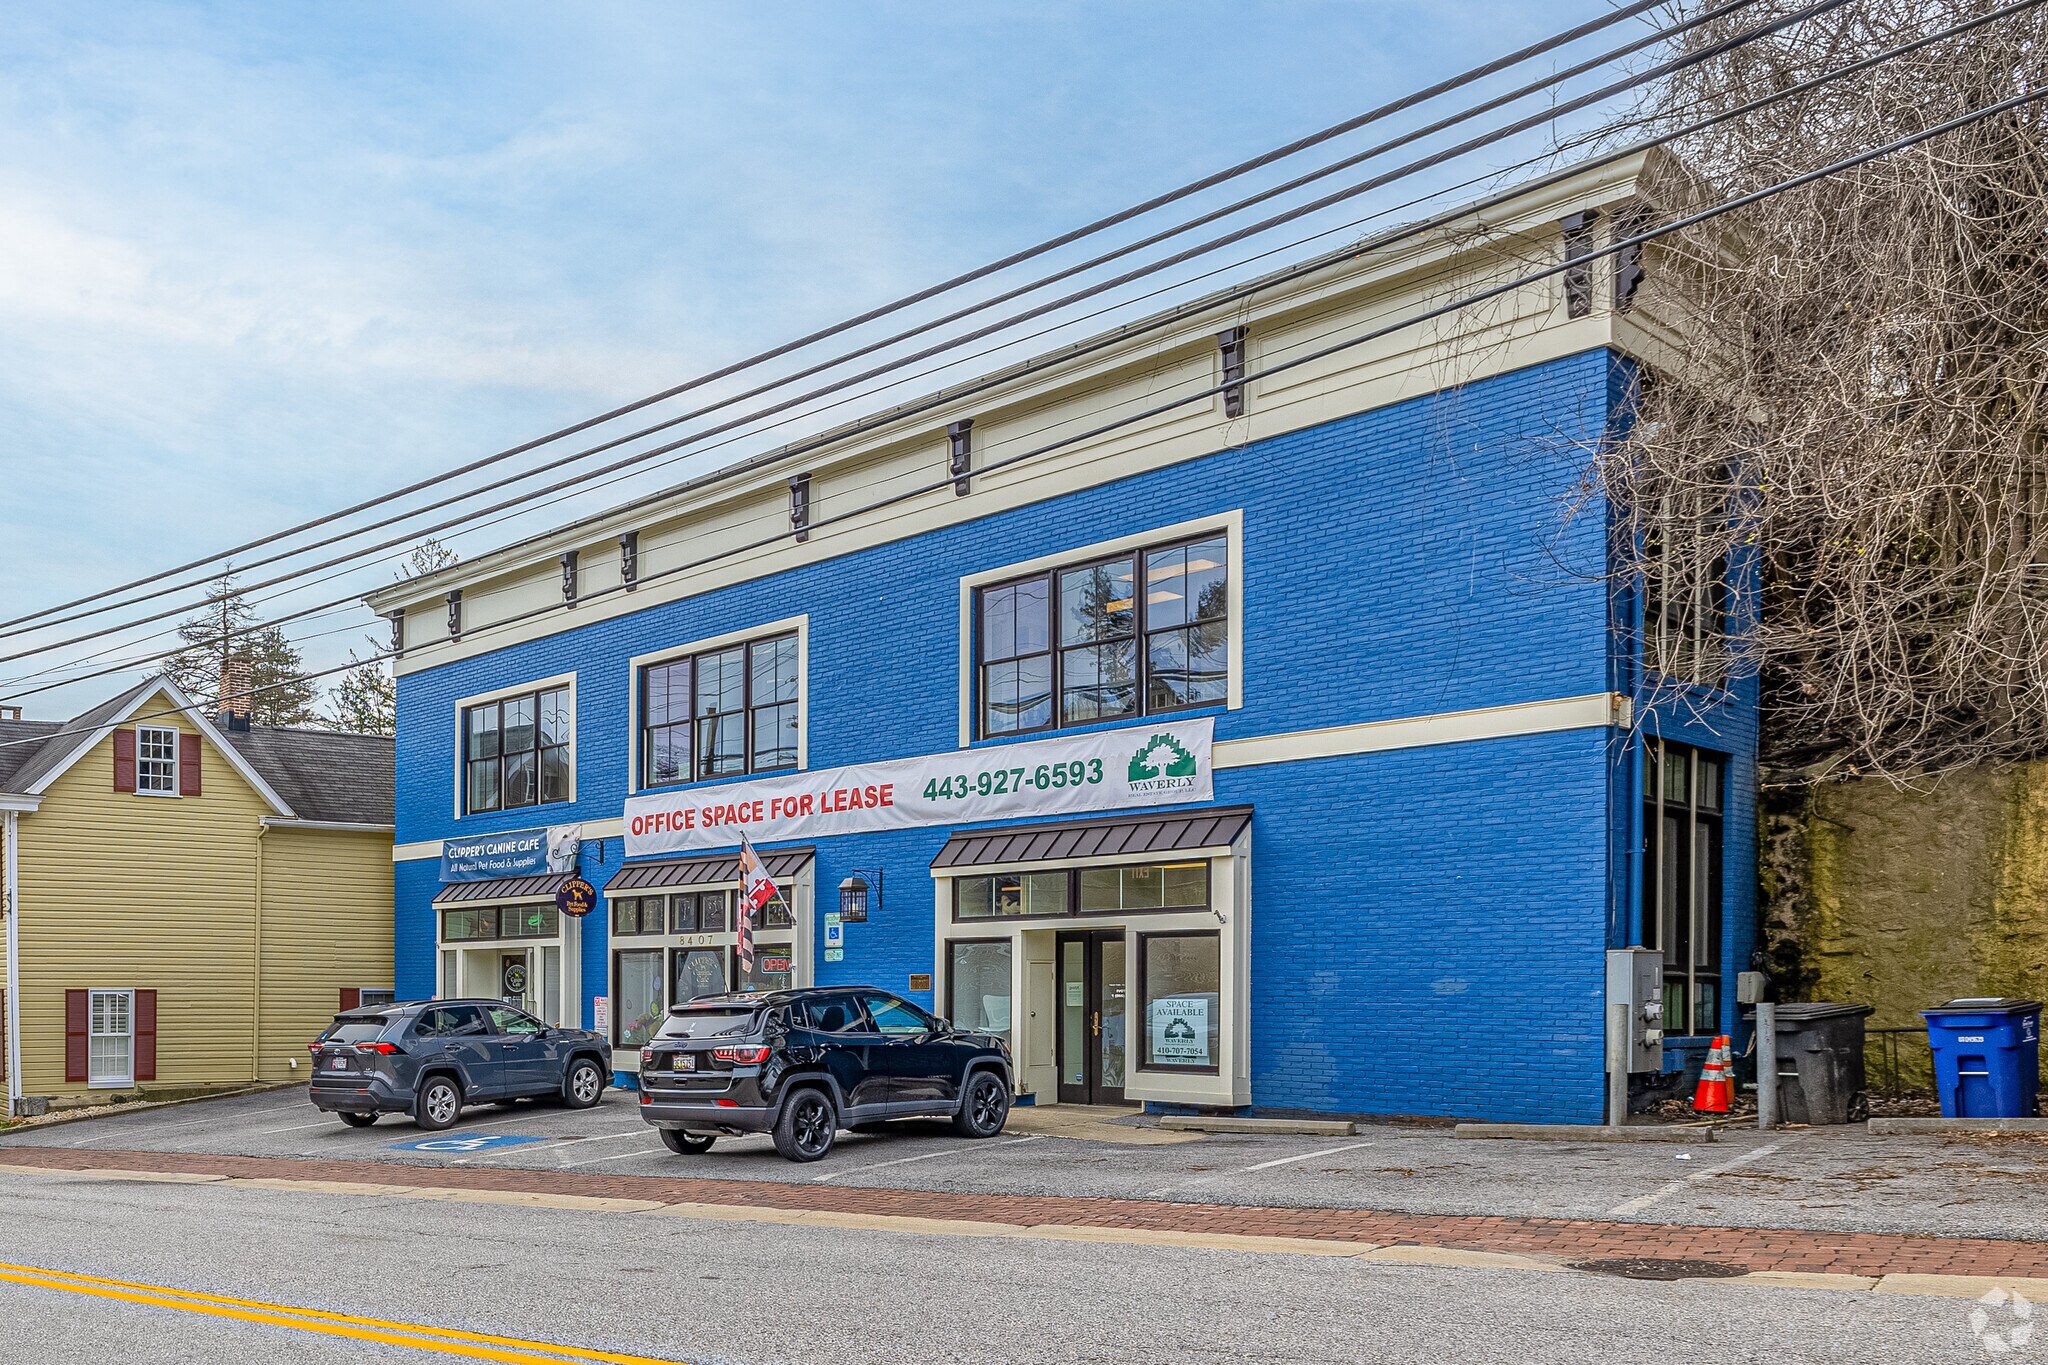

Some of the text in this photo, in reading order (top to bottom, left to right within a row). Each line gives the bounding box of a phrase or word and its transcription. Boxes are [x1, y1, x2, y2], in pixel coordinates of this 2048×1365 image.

[923, 758, 1104, 801] 443-927-6593
[1129, 777, 1196, 792] WAVERLY
[631, 784, 894, 836] OFFICE SPACE FOR LEASE
[448, 838, 540, 859] CLIPPER'S CANINE CAFE
[459, 861, 477, 872] Natural
[478, 860, 488, 870] Pet
[489, 858, 505, 868] Food
[506, 858, 512, 867] &
[513, 857, 536, 868] Supplies
[561, 880, 594, 896] CLIPPER'S
[680, 935, 713, 946] 8407
[763, 958, 791, 971] OPEN
[1166, 1000, 1194, 1008] SPACE
[1157, 1047, 1203, 1055] 410-707-7054
